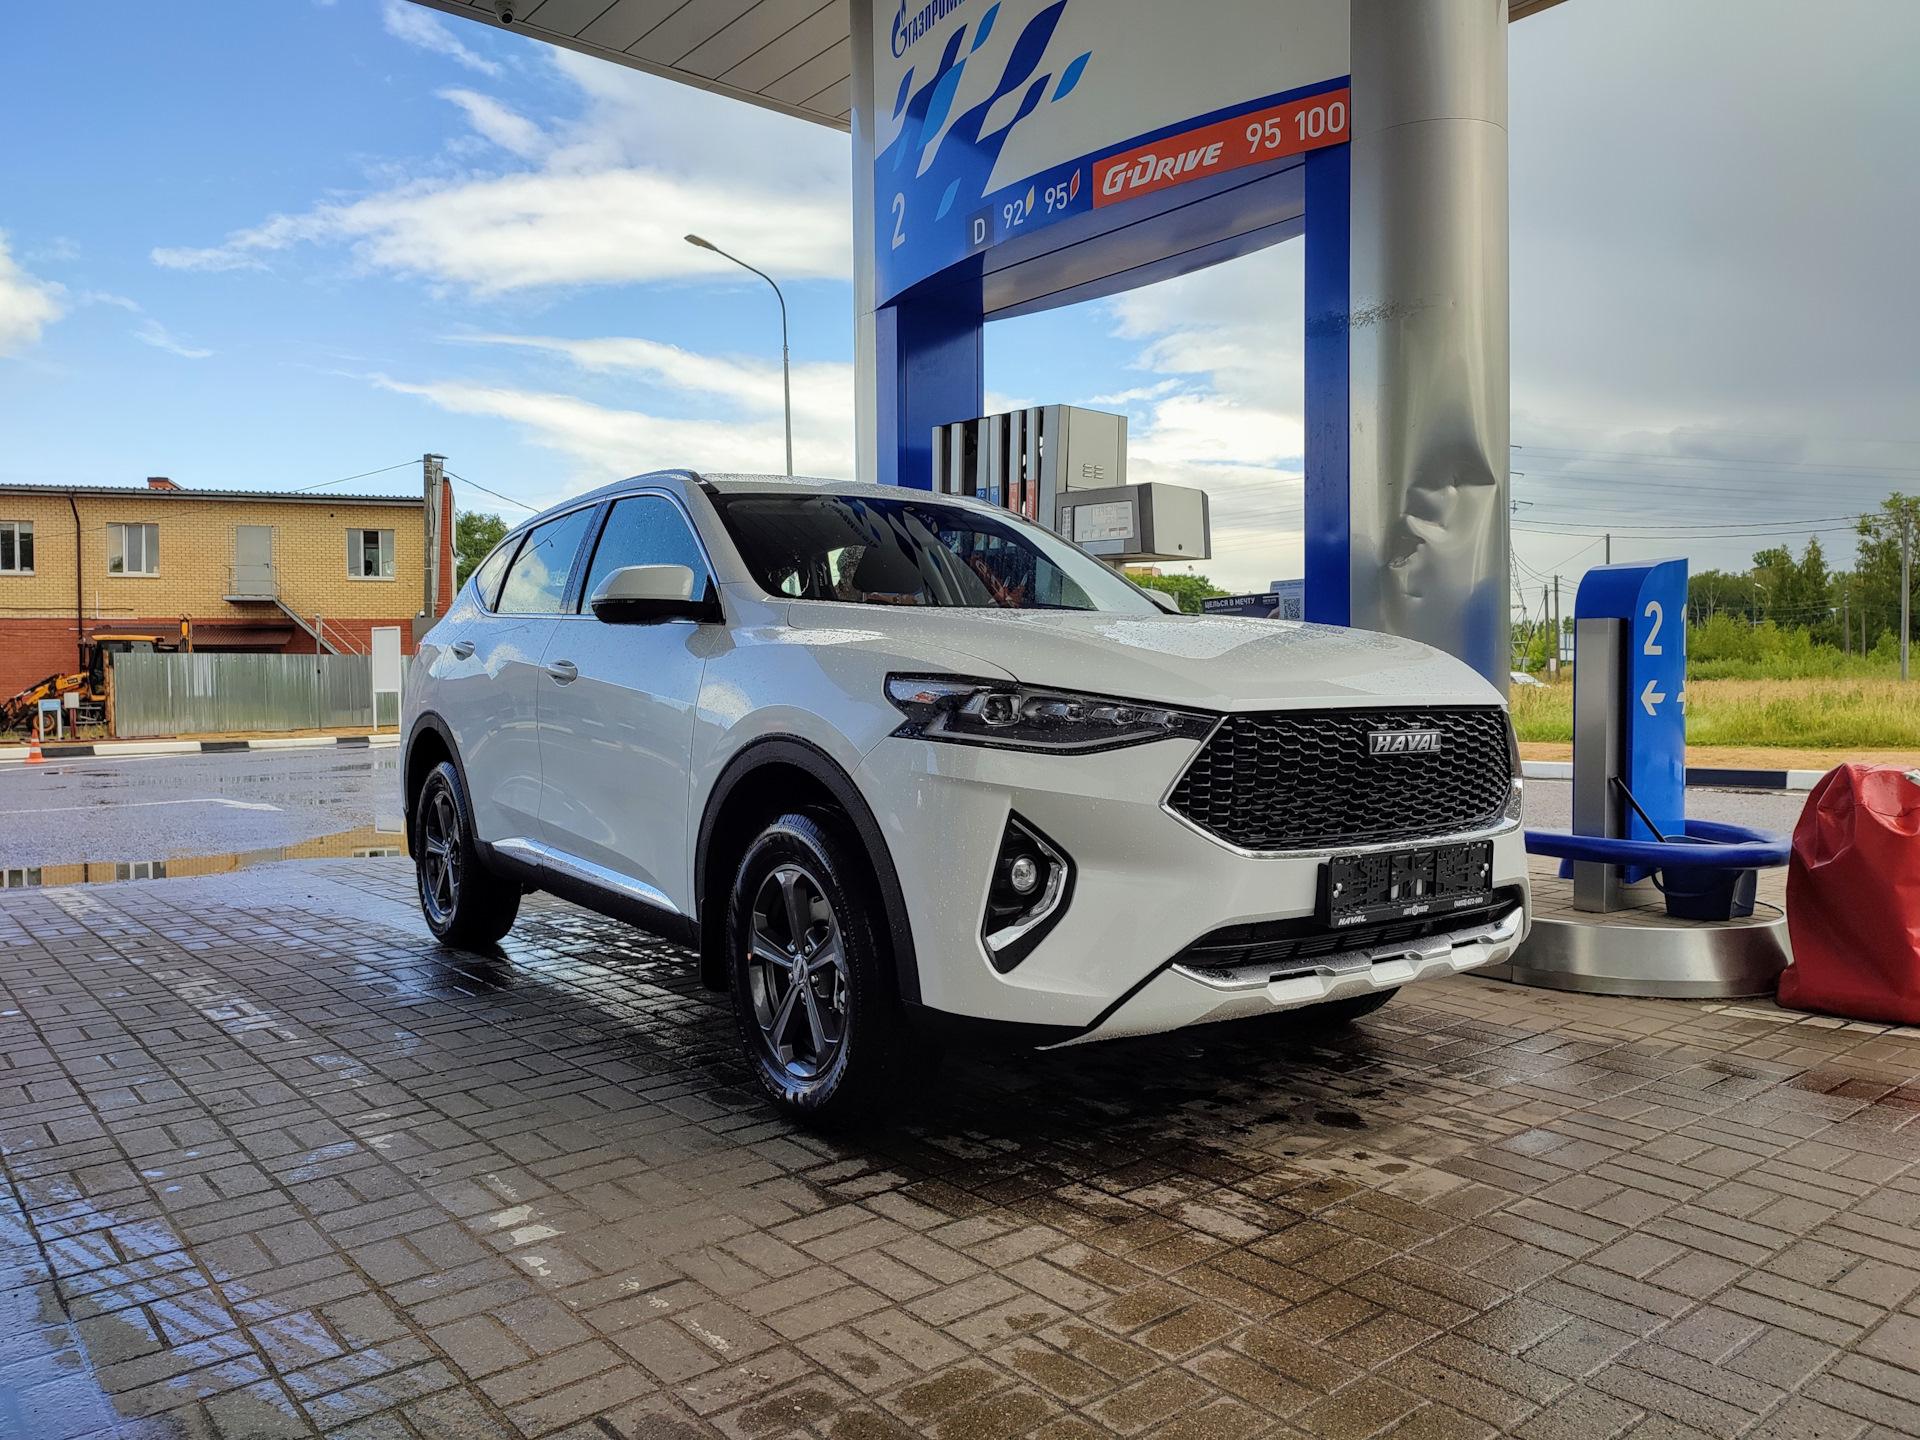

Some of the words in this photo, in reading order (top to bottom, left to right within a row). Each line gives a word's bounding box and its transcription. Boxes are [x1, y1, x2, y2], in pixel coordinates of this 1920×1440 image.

[908, 0, 965, 47] ГАЗПРОМ
[1245, 117, 1281, 154] 95
[1294, 101, 1345, 141] 100
[891, 192, 906, 250] 2
[974, 218, 986, 245] D
[1003, 199, 1024, 229] 92
[1045, 182, 1068, 214] 95
[1235, 597, 1255, 606] МЕЧТУ
[1643, 601, 1662, 655] 2
[1374, 734, 1441, 752] HAVAL
[1337, 914, 1367, 926] HAVAL
